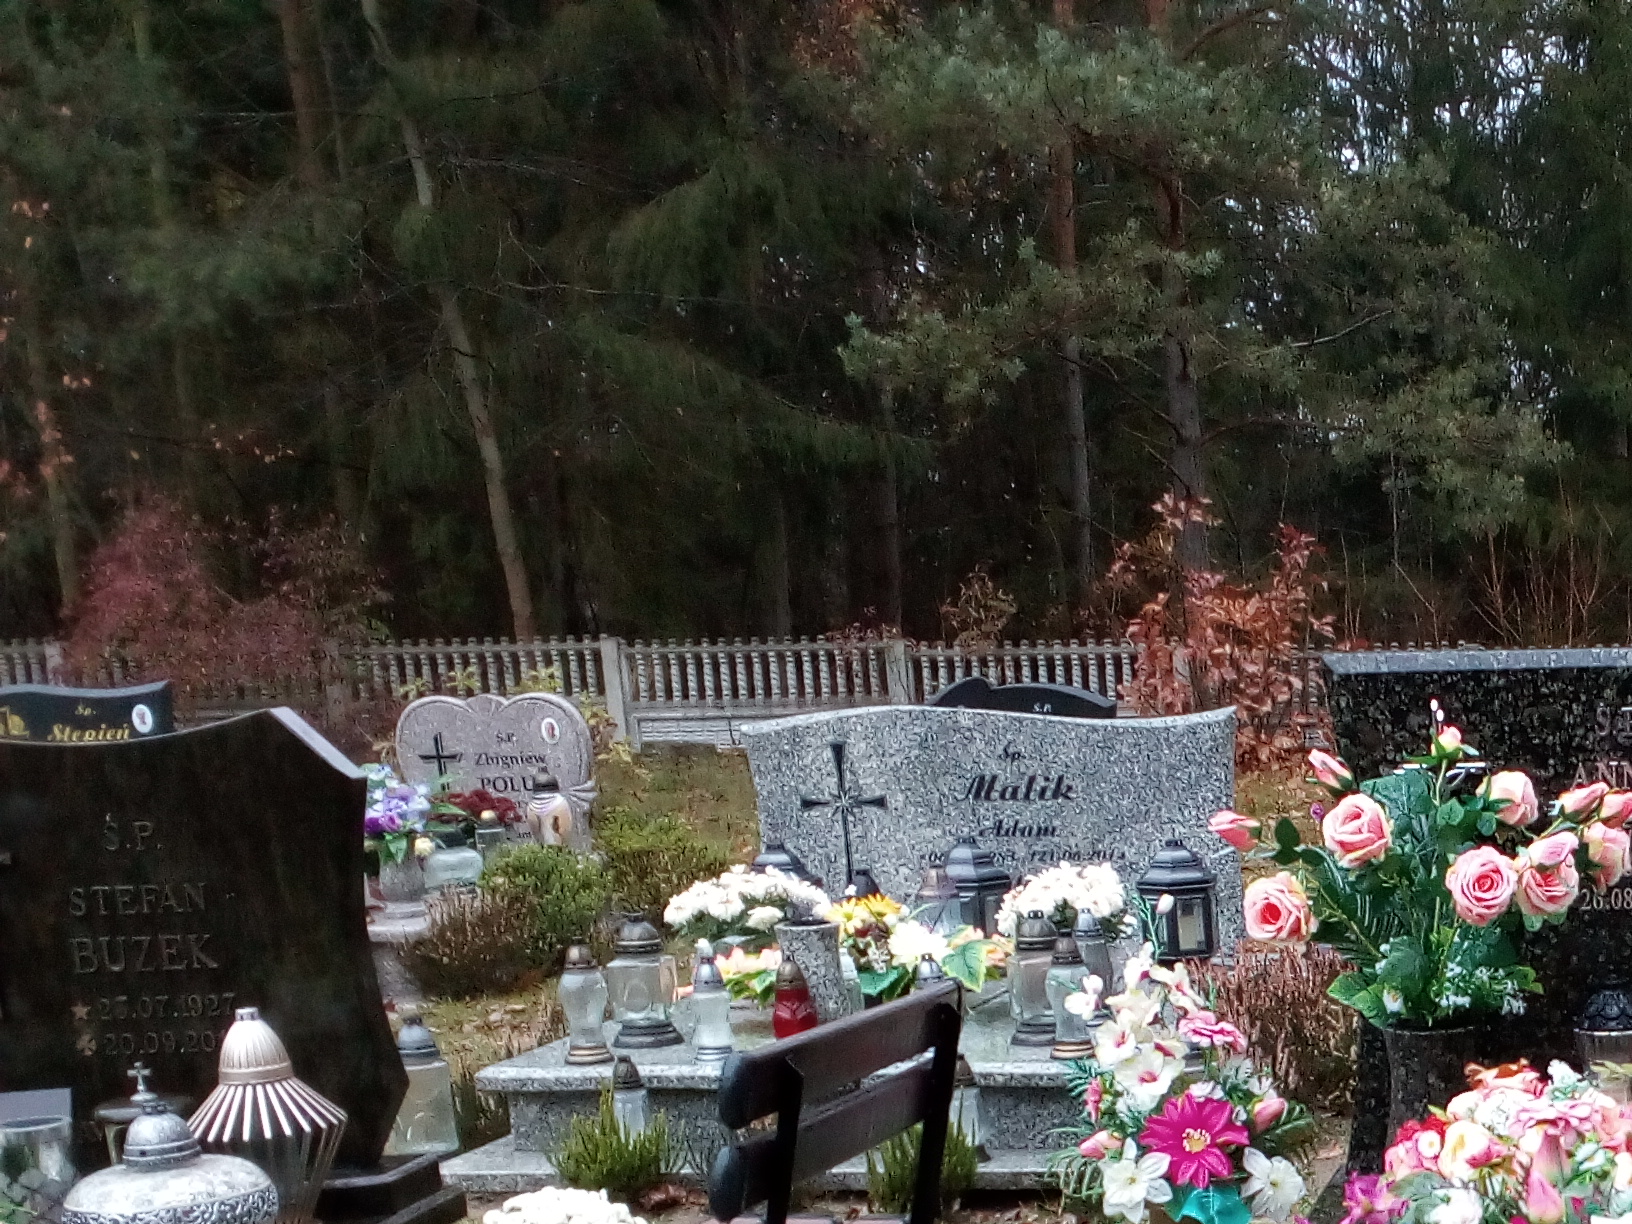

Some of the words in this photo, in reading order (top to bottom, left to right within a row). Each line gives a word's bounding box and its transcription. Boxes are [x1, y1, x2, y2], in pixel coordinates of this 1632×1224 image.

[955, 774, 1074, 802] Malik
[978, 820, 1057, 837] Adam
[68, 881, 208, 917] STEFAN
[69, 932, 220, 975] BUZEK
